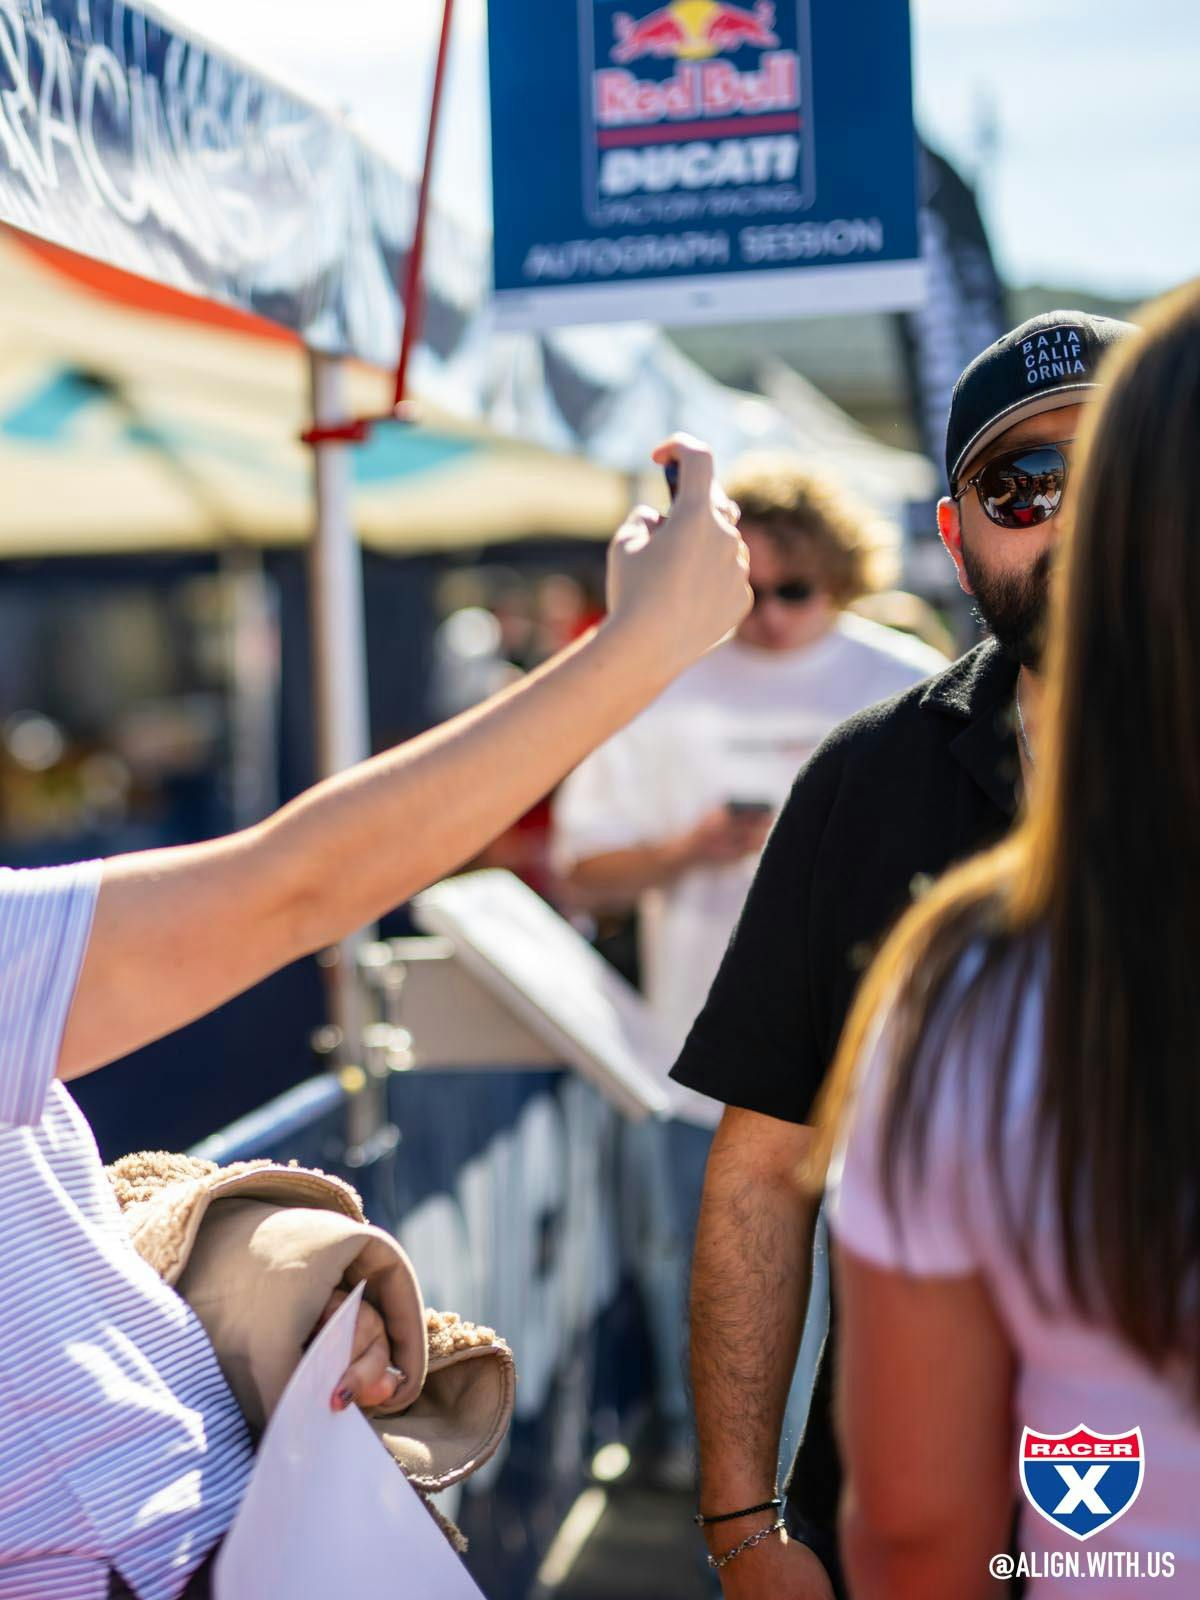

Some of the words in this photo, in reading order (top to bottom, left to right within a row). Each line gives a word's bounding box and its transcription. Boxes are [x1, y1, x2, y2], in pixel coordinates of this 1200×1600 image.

[599, 134, 799, 195] DUCATI
[521, 230, 730, 279] AUTOGRAPH
[738, 217, 884, 263] SESSION
[1022, 330, 1080, 355] BAJA
[1025, 344, 1081, 369] CALIF
[1027, 359, 1086, 384] ORNIA
